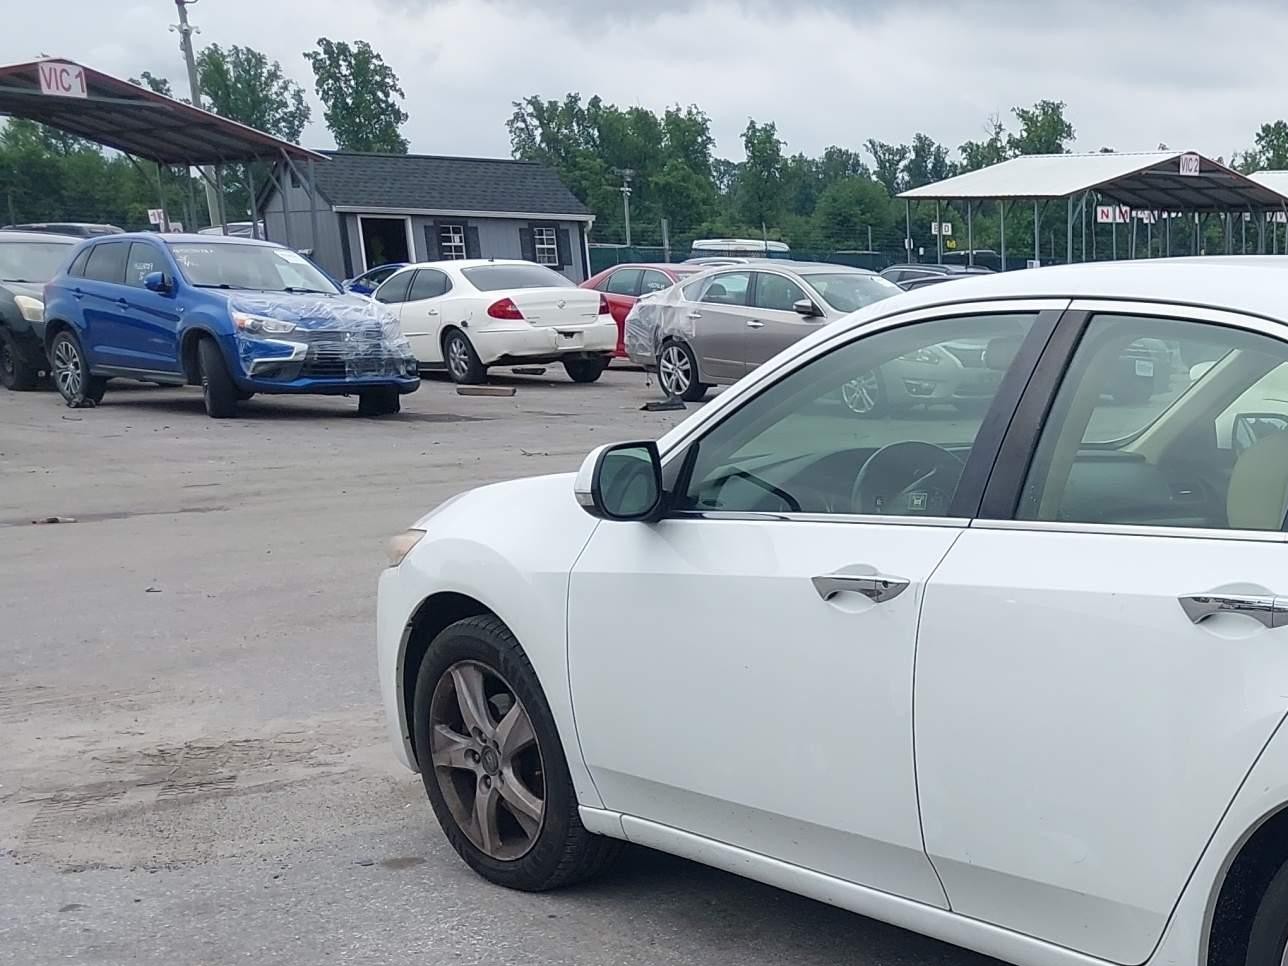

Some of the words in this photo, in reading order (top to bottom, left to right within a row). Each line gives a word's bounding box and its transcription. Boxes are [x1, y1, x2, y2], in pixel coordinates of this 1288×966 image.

[40, 66, 72, 92] VIC
[75, 70, 85, 93] 1
[1101, 208, 1110, 220] N
[943, 223, 950, 233] D
